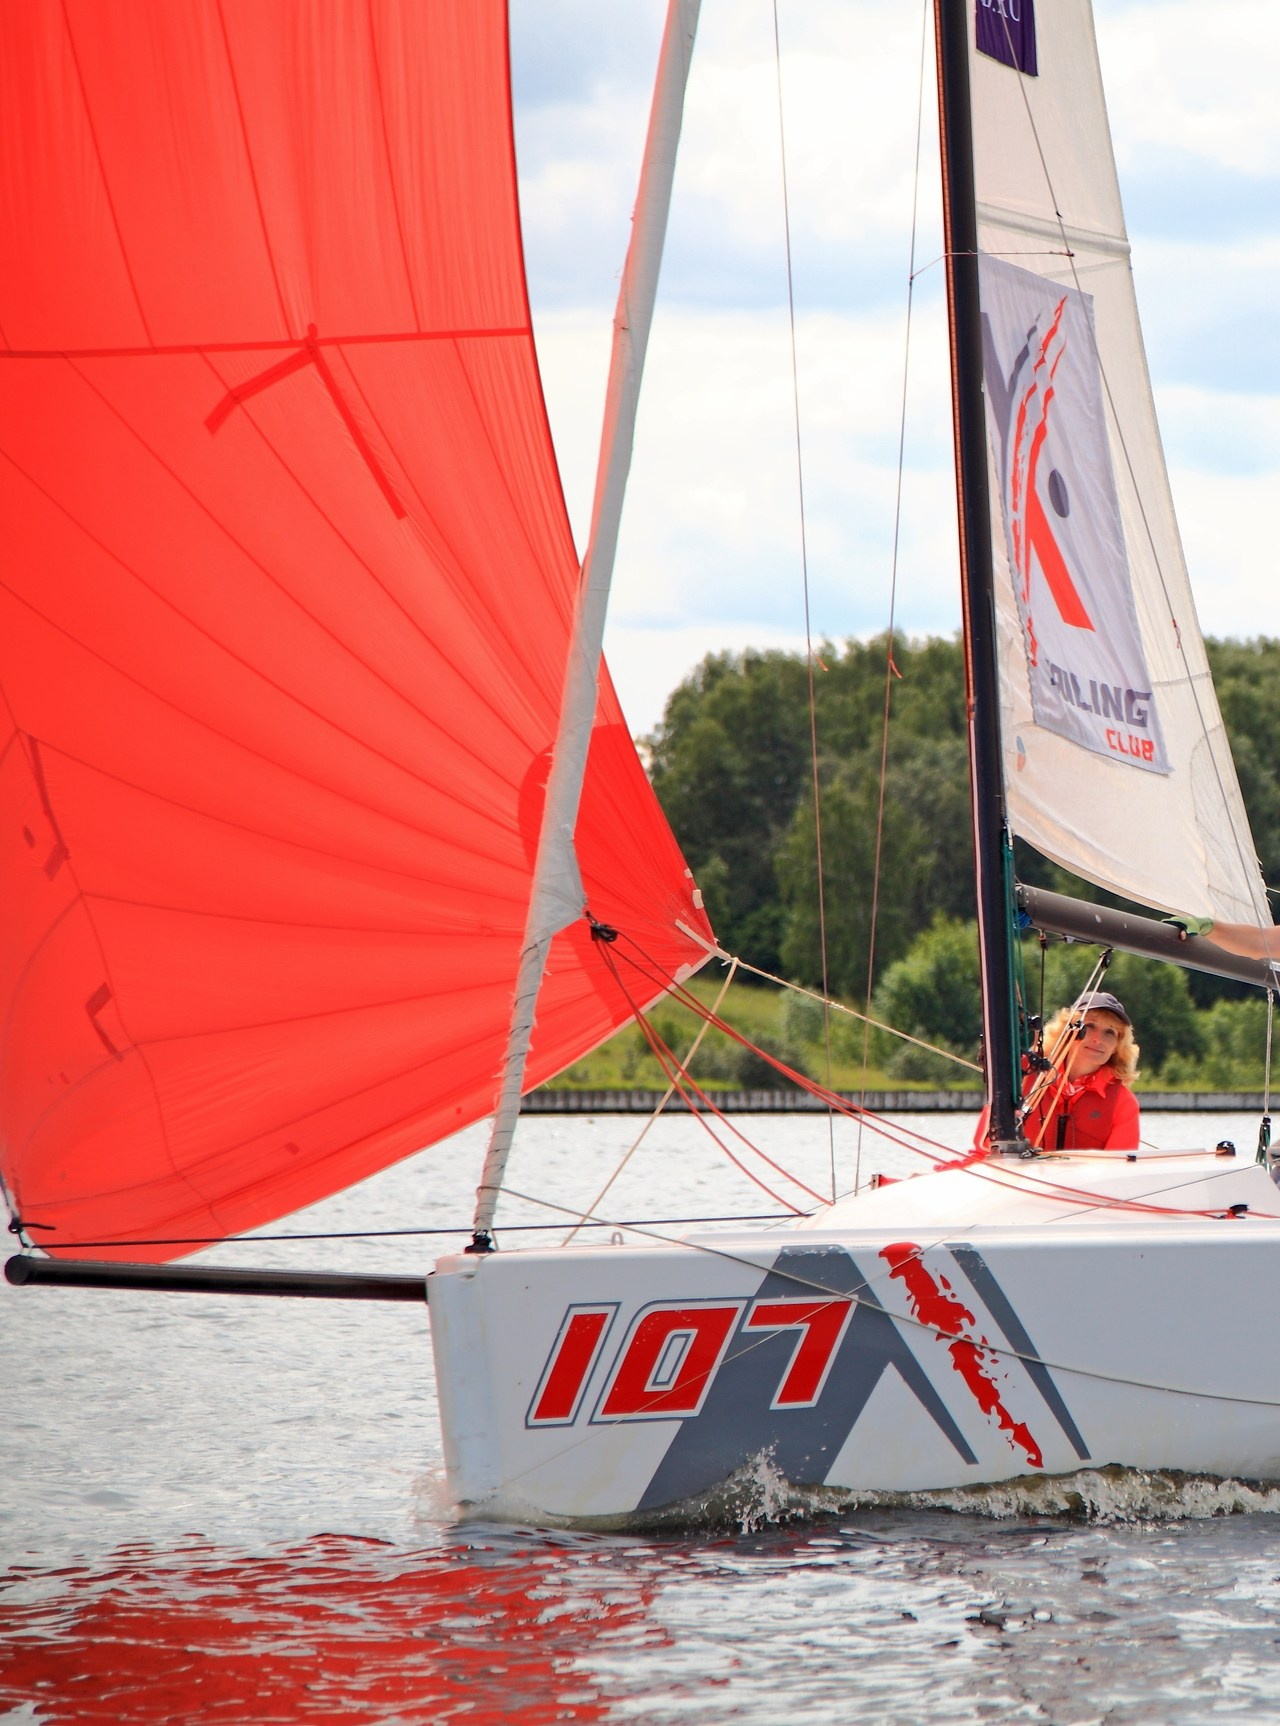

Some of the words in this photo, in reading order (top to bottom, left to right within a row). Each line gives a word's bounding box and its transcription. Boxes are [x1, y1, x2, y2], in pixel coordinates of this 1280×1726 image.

[1045, 658, 1152, 728] AILING
[1106, 728, 1154, 762] CLUB
[525, 1295, 858, 1429] 107
